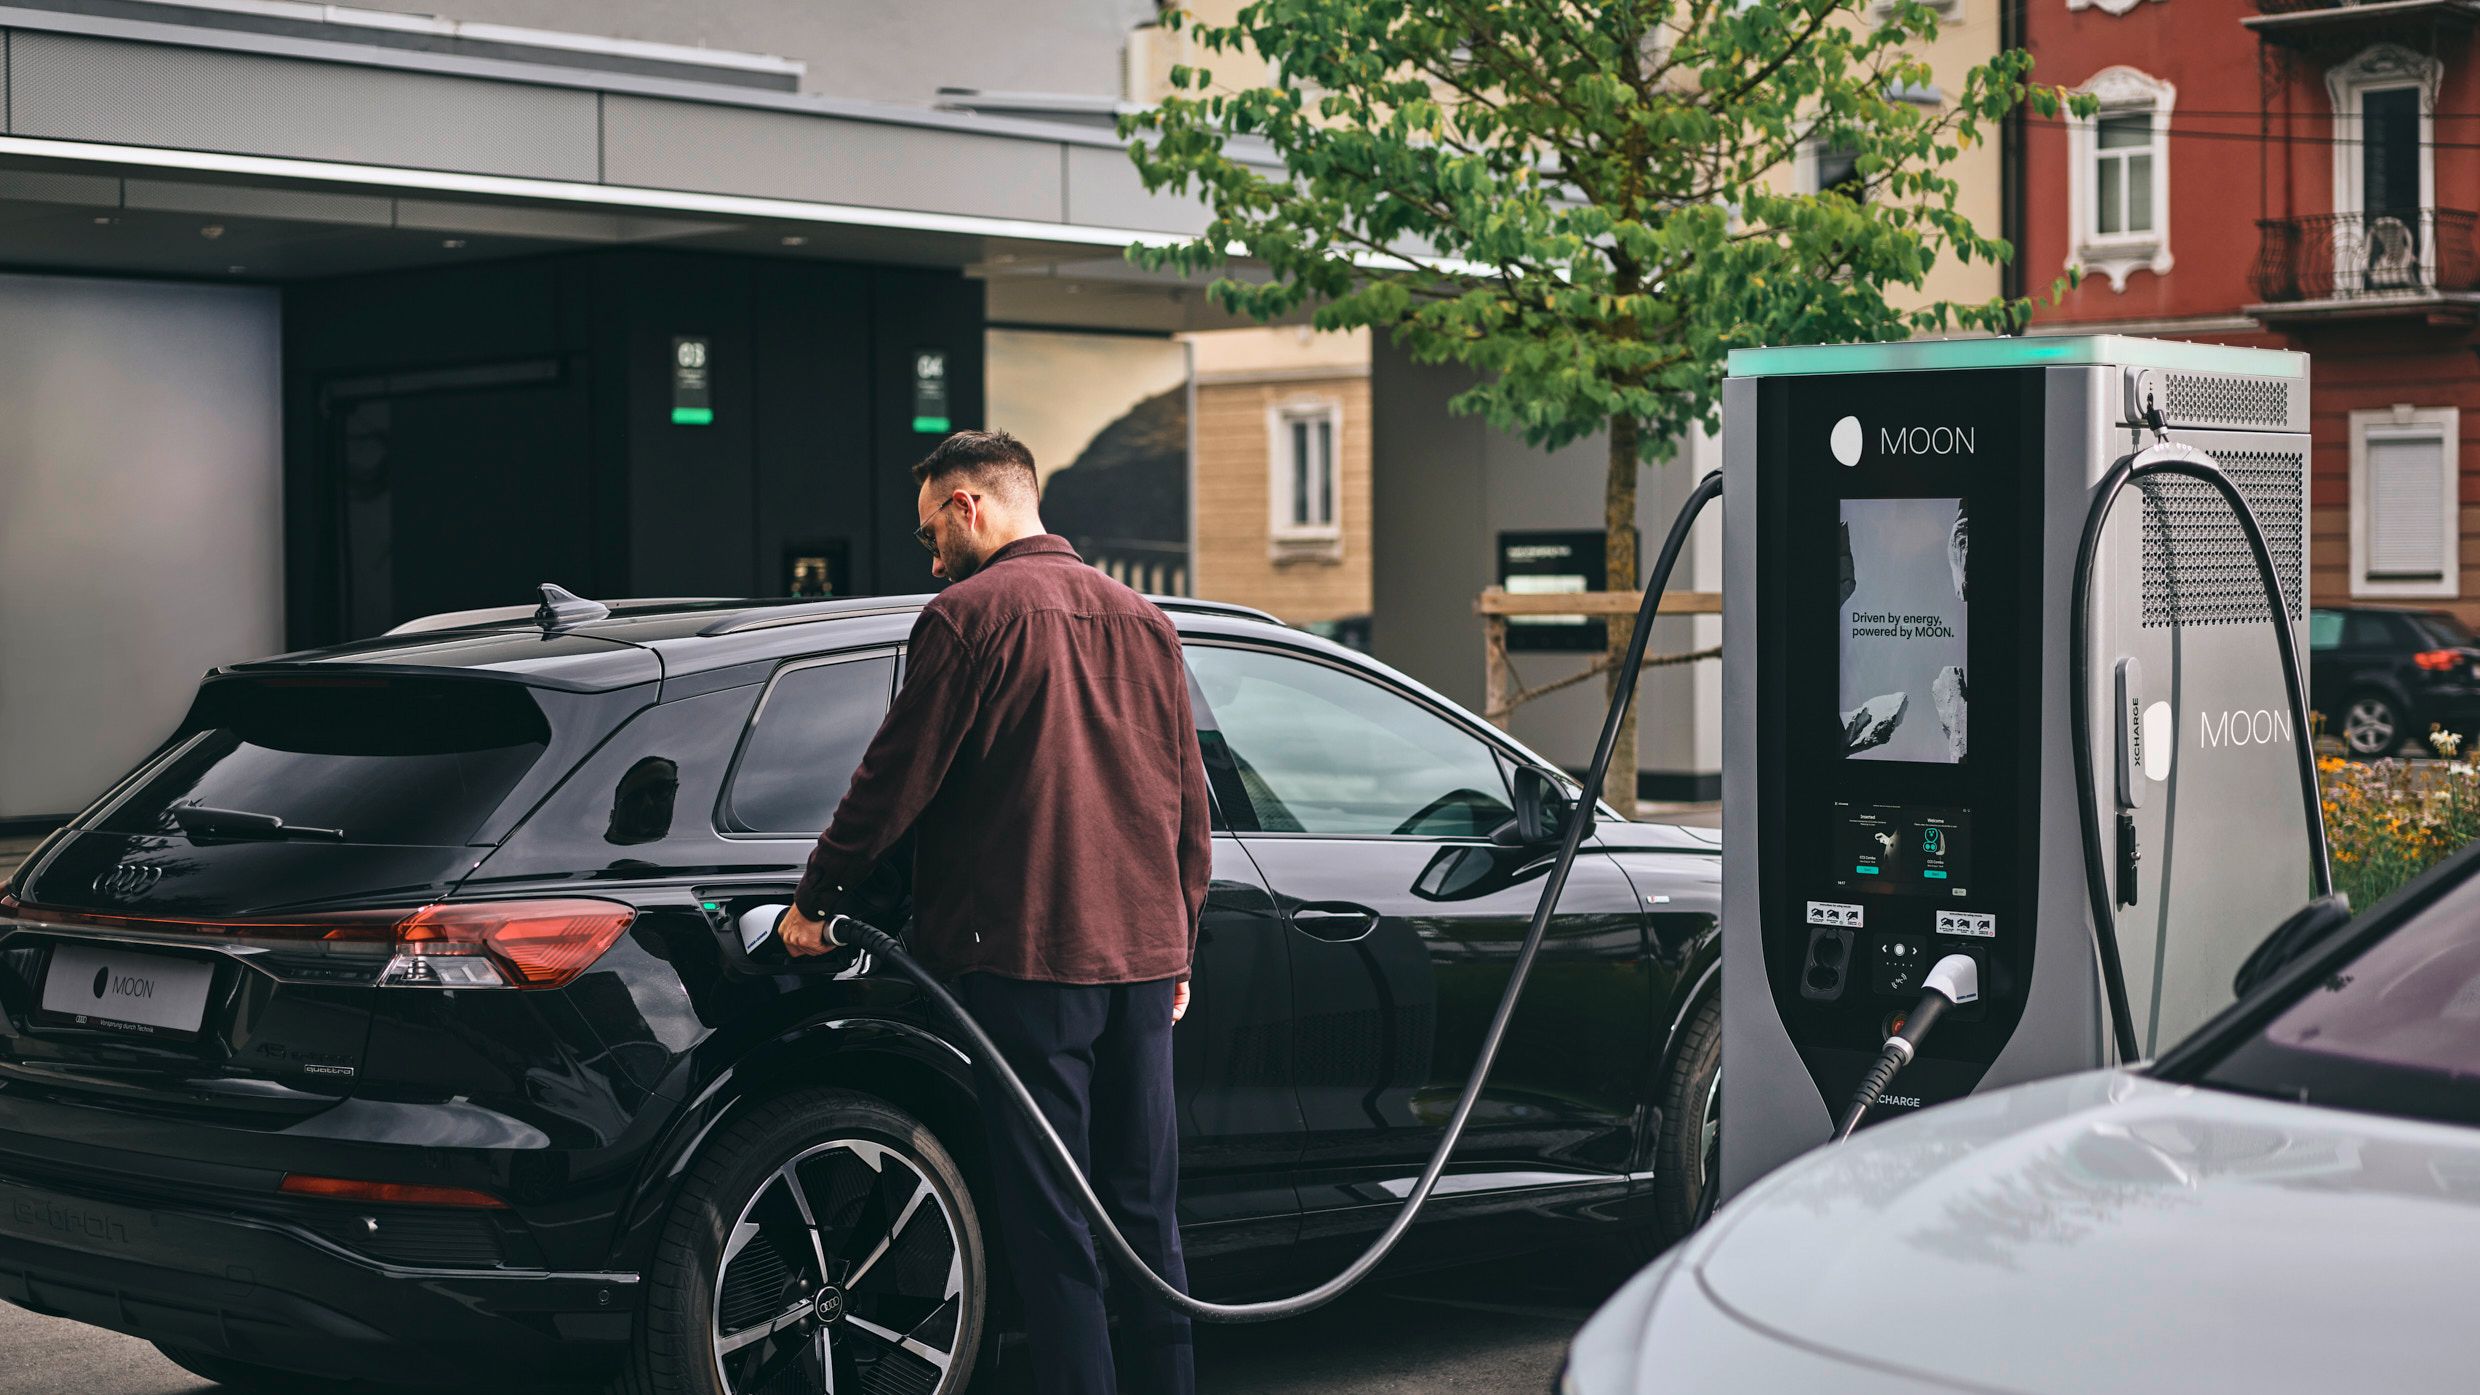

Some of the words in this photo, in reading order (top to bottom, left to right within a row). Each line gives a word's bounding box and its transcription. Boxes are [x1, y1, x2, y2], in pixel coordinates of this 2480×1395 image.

[1881, 427, 1975, 454] MOON
[1852, 612, 1885, 623] Driven
[1888, 612, 1900, 625] by
[1903, 615, 1942, 626] energy,
[1852, 626, 1897, 639] powered
[1900, 626, 1913, 639] by
[1915, 627, 1955, 638] MOON.
[2132, 697, 2141, 767] XCHARGE
[2201, 709, 2291, 749] MOON
[112, 975, 154, 998] MOON
[306, 1065, 352, 1076] quattro
[1876, 1094, 1920, 1107] CHARGE
